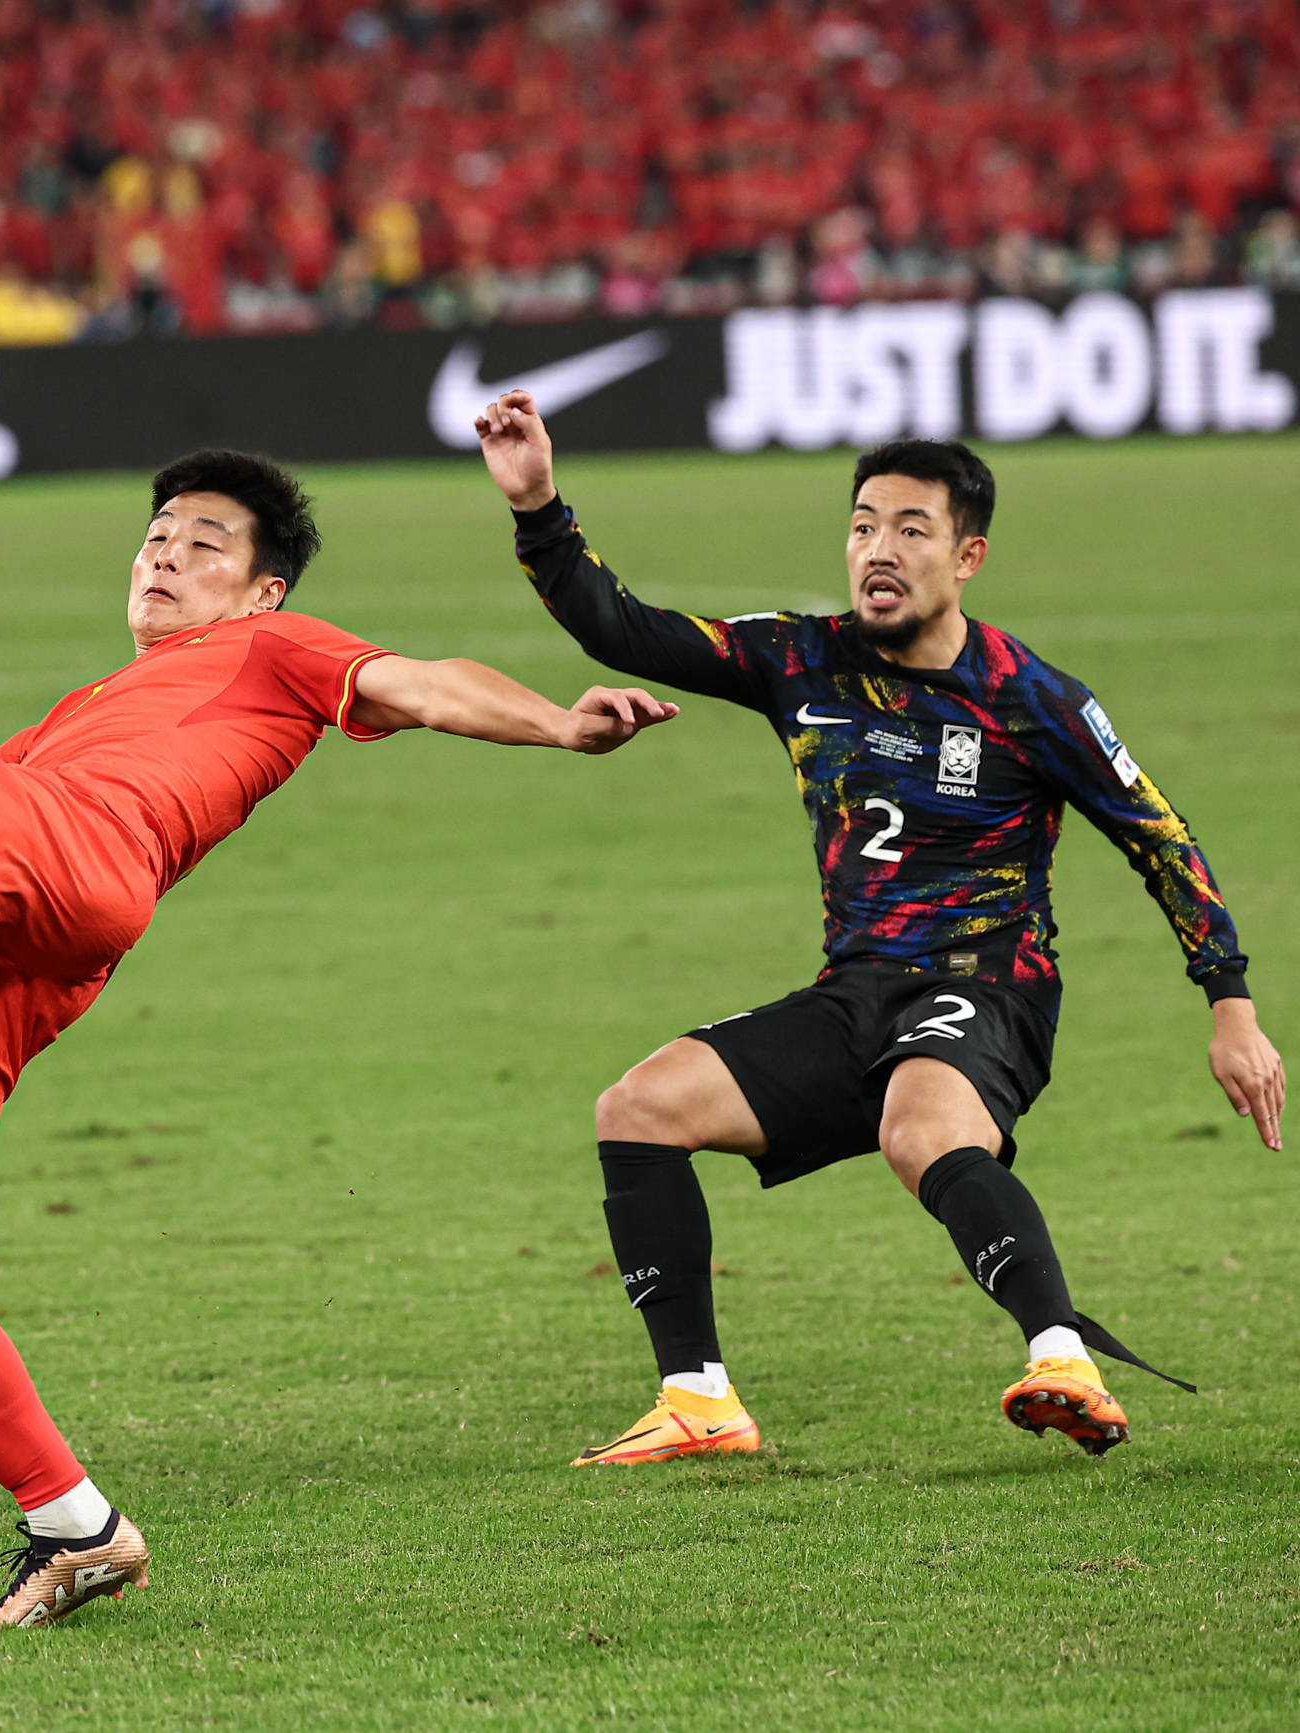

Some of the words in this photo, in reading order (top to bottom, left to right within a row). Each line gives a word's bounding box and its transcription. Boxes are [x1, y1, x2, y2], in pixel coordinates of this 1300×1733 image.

[707, 303, 968, 452] JUST
[973, 293, 1153, 441] DO
[935, 783, 977, 798] KOREA
[860, 797, 905, 863] 2
[915, 993, 977, 1039] 2
[976, 1236, 1016, 1284] REA
